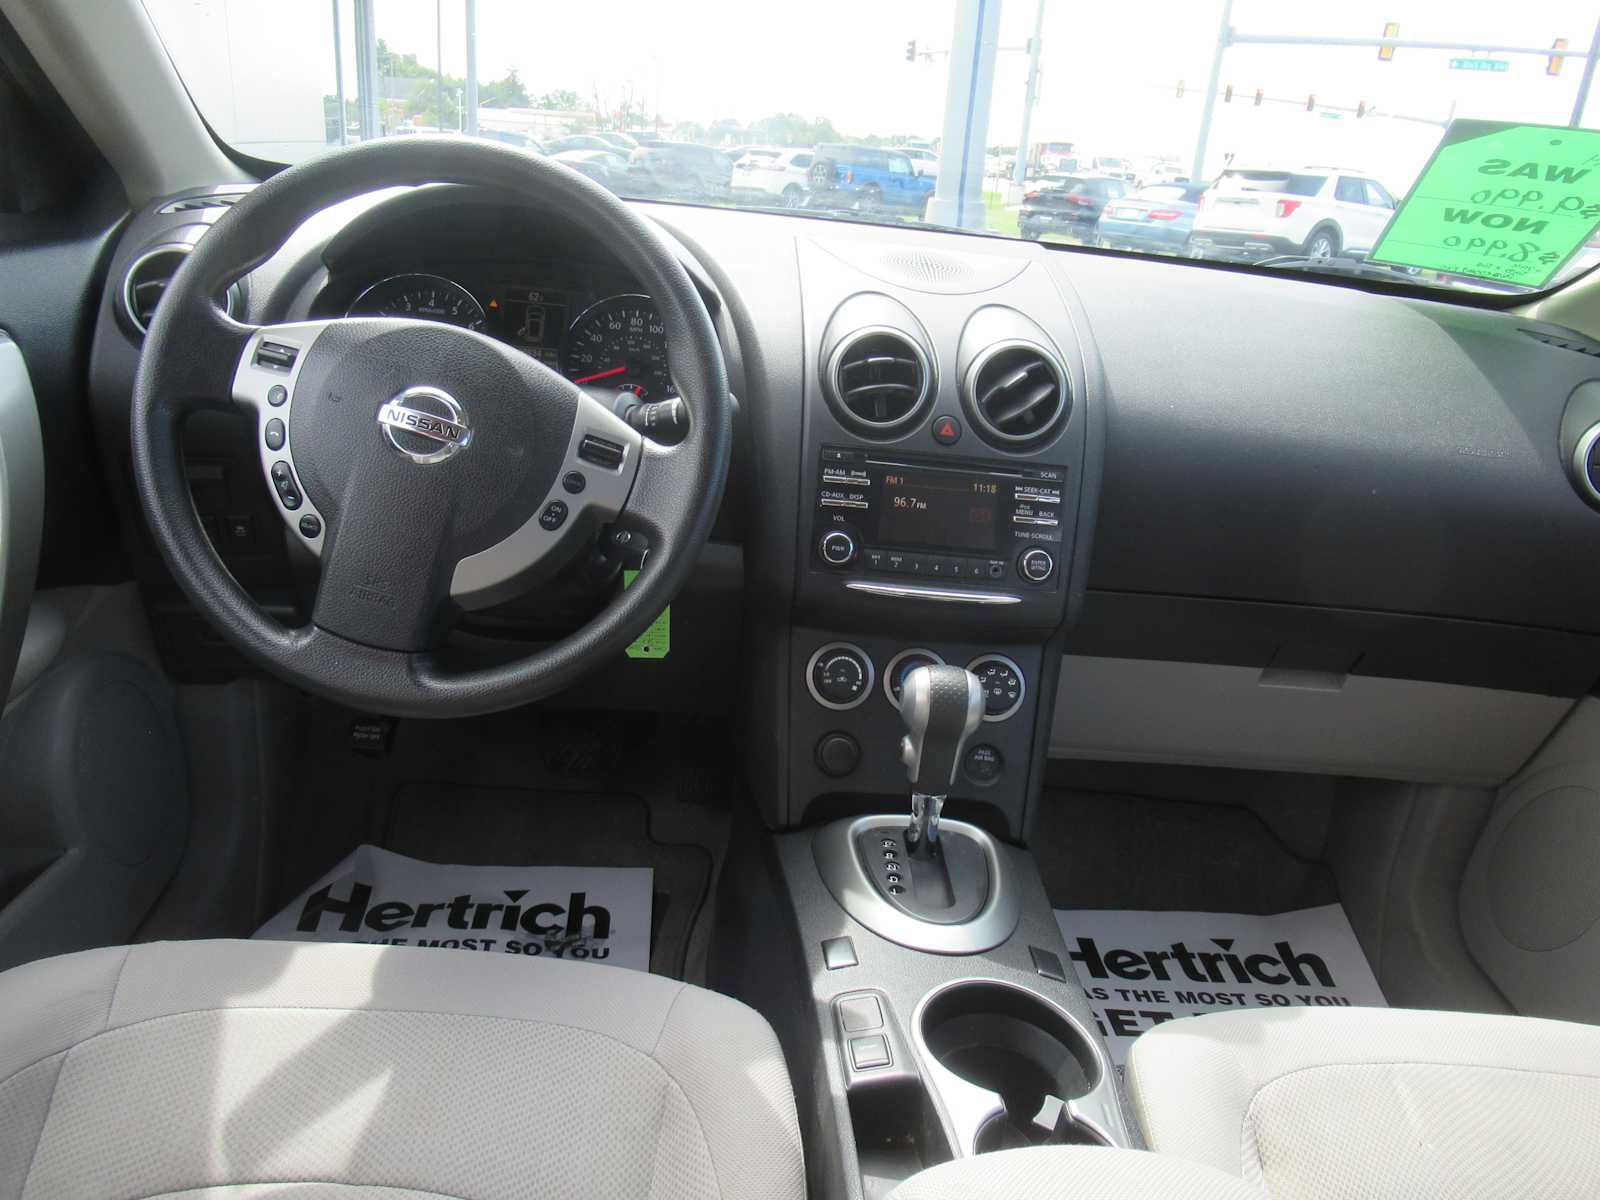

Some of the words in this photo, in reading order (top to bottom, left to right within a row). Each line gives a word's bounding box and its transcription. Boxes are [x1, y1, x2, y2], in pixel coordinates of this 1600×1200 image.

[609, 322, 621, 330] 60
[630, 318, 643, 327] 80
[649, 325, 664, 333] 100
[590, 334, 602, 342] 40
[581, 354, 593, 363] 20
[386, 407, 460, 440] NISSAN
[885, 475, 898, 485] FM
[1040, 471, 1057, 480] SCAN
[973, 483, 998, 494] 11:18
[832, 514, 846, 523] VOL
[1038, 511, 1055, 519] BACK
[296, 882, 611, 939] Hertrich
[1115, 988, 1170, 1004] THE
[1174, 991, 1248, 1007] MOST
[1256, 993, 1292, 1007] SO
